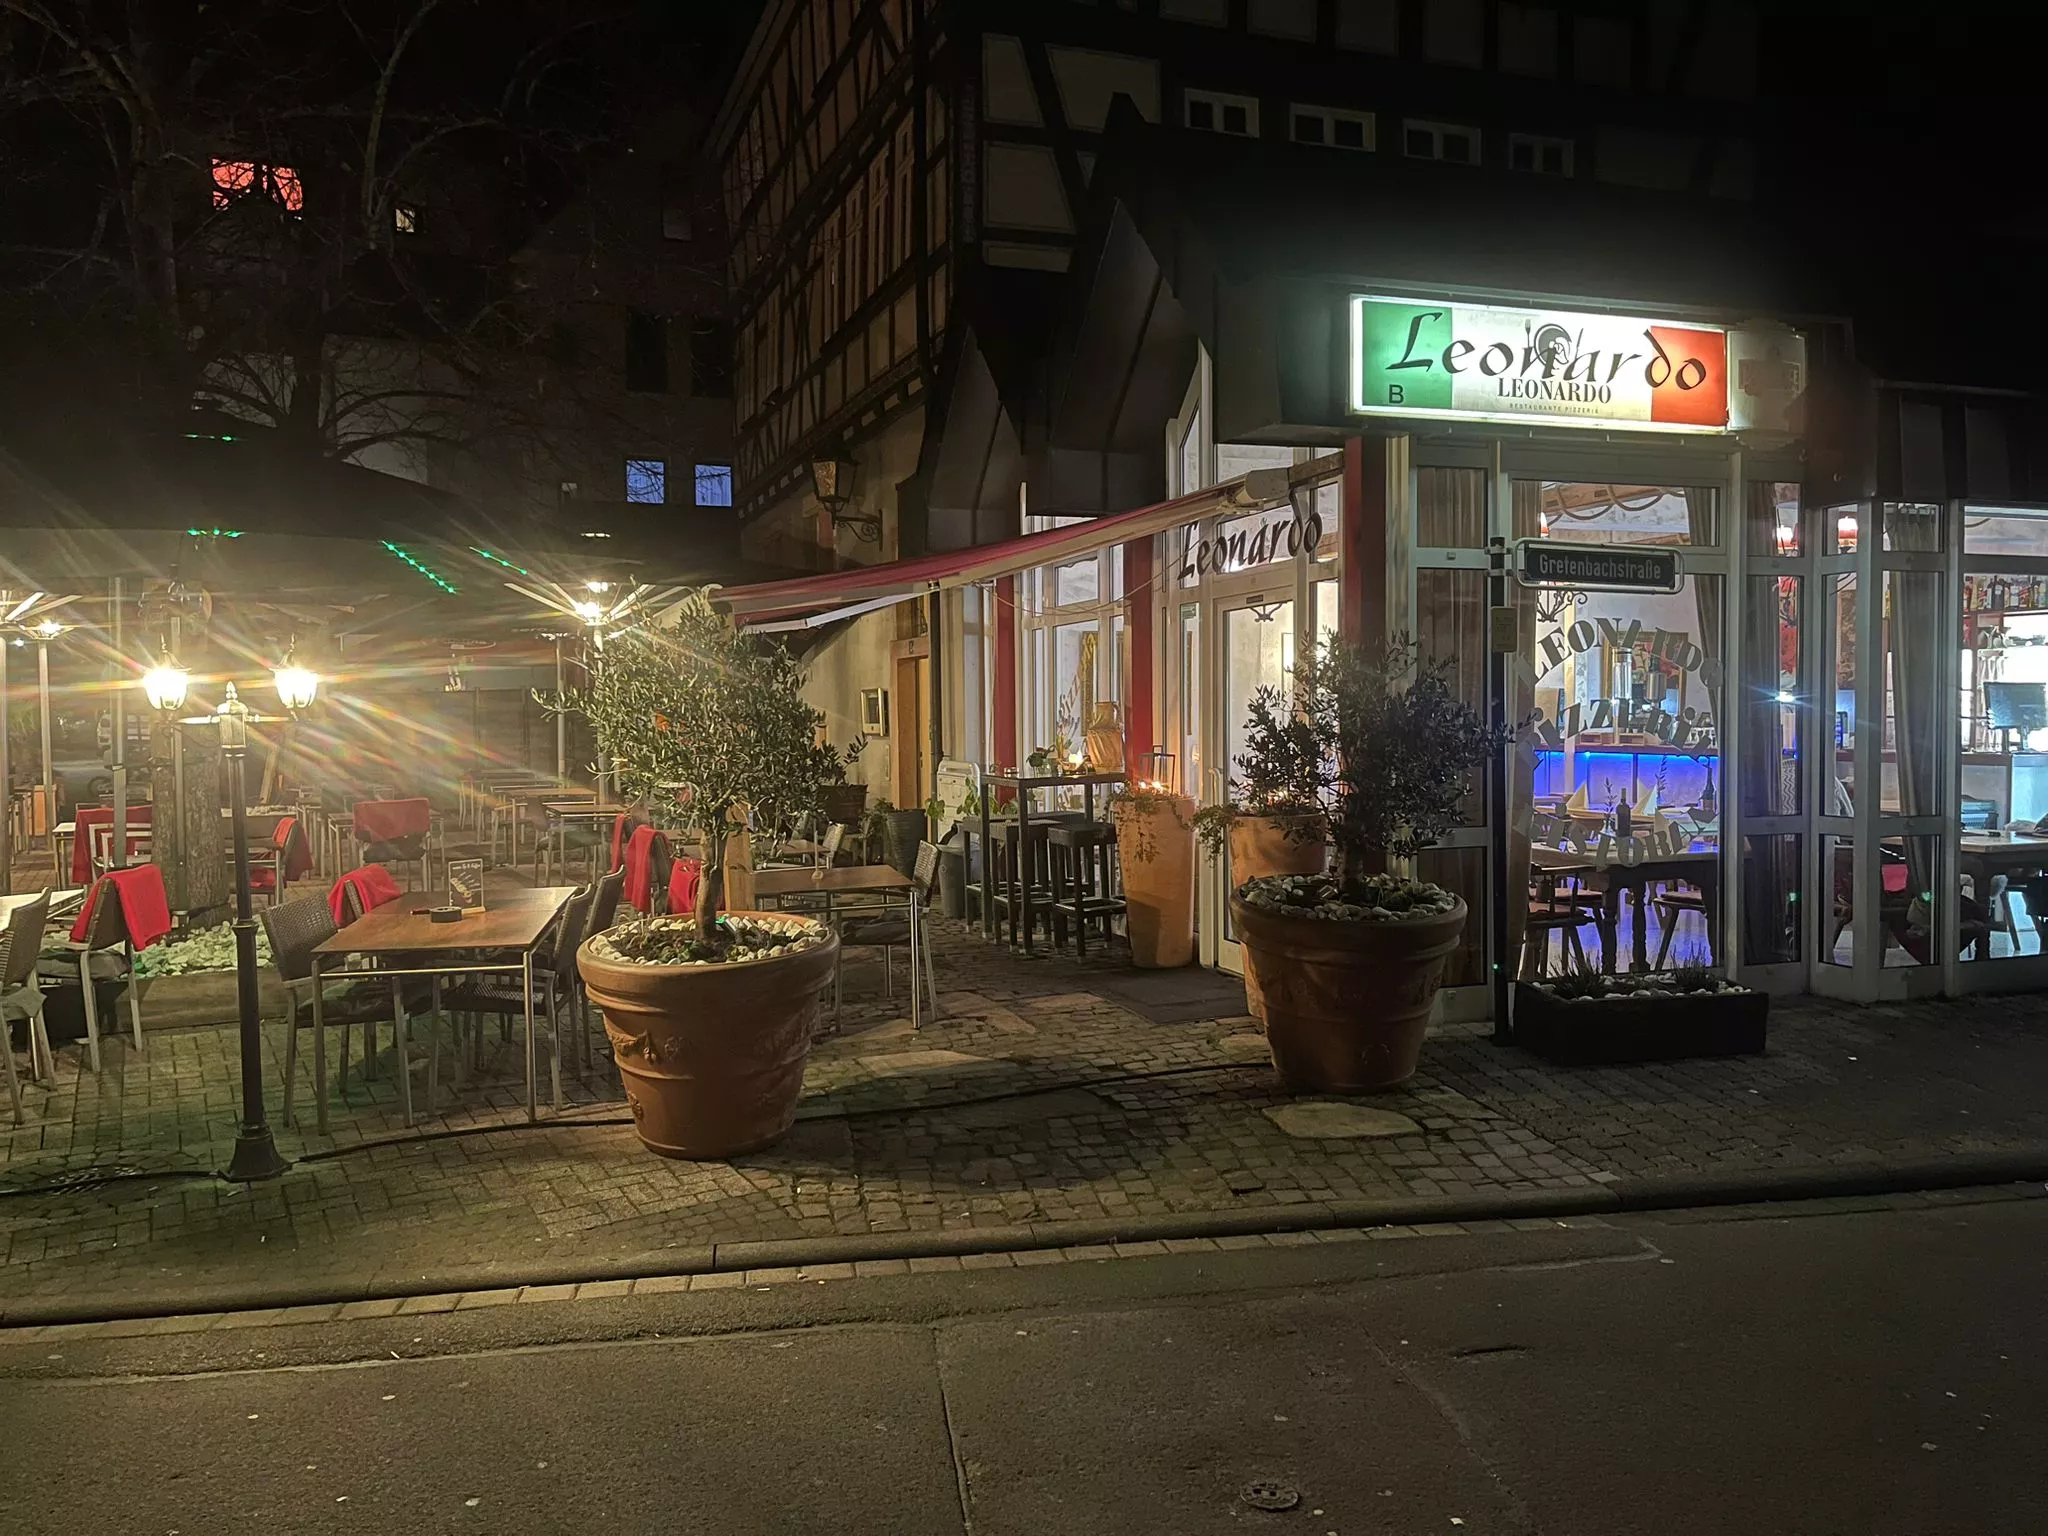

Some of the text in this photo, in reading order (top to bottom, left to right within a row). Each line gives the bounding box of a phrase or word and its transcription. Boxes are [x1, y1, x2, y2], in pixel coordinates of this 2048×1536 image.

[1385, 312, 1707, 391] Leonardo
[1388, 384, 1405, 404] B
[1497, 377, 1612, 404] LEONARDO
[1177, 488, 1323, 581] Leonardo
[1539, 553, 1661, 580] Gretenbachstraße
